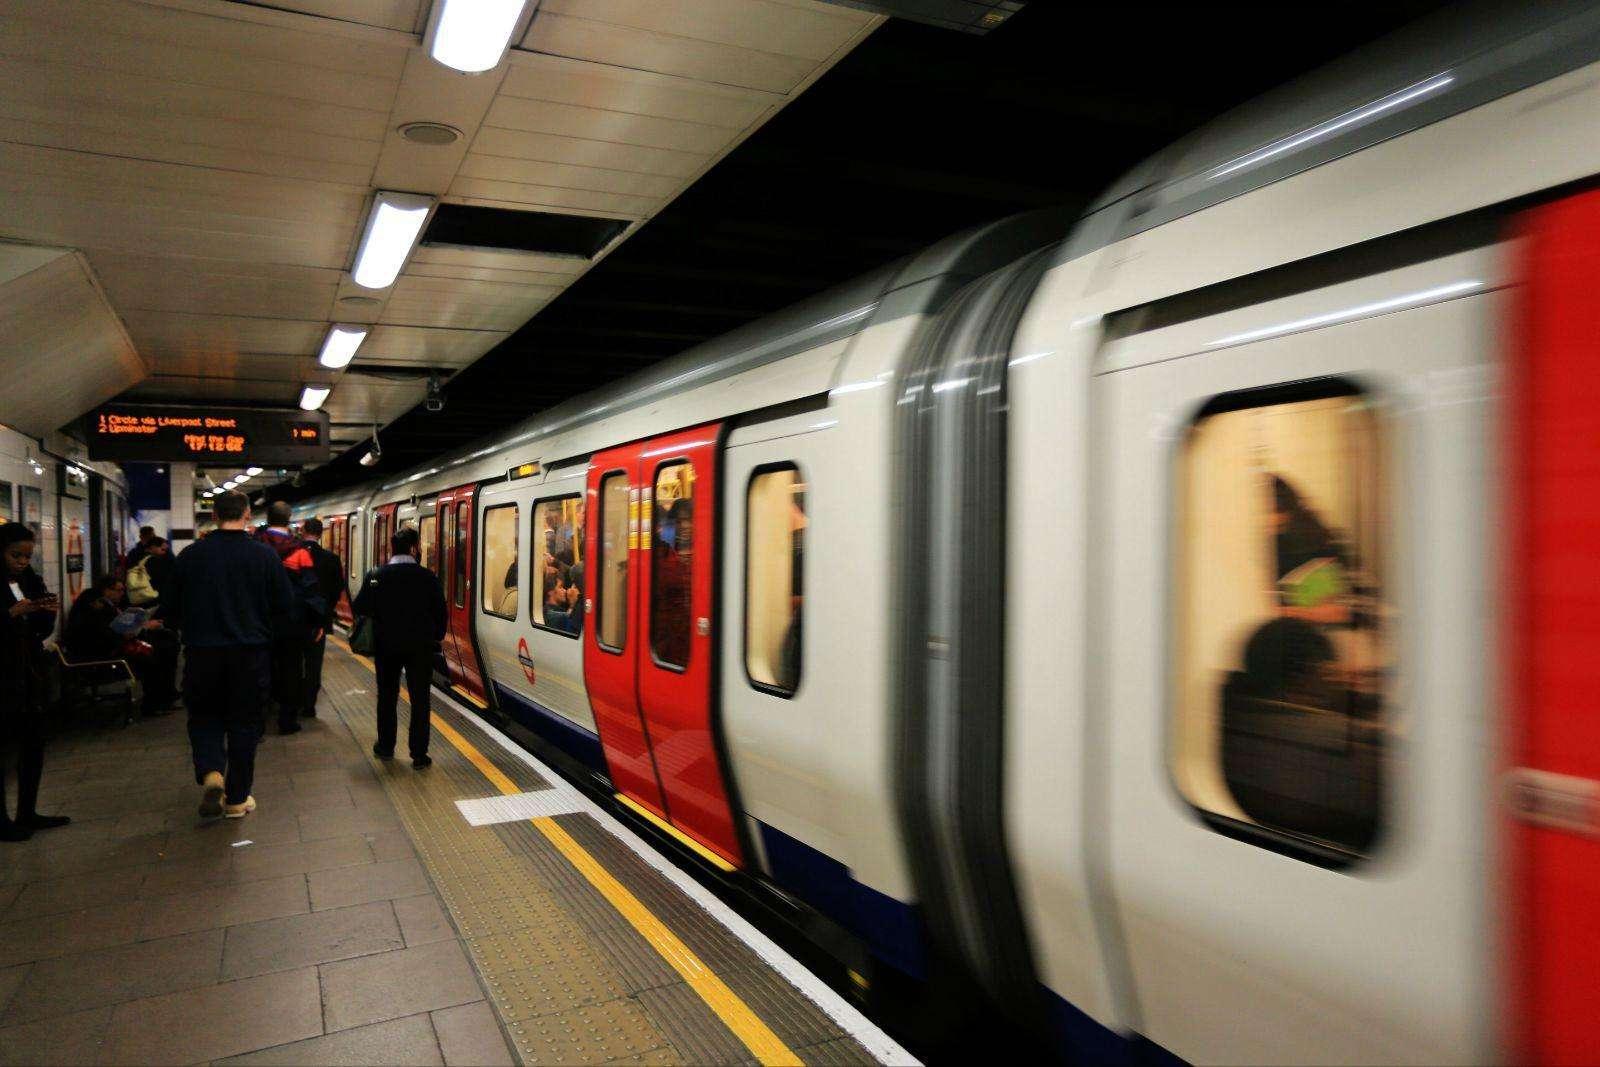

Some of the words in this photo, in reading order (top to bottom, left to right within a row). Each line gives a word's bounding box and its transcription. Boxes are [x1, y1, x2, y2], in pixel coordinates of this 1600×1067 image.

[108, 414, 139, 425] Circle
[141, 416, 157, 425] via
[158, 417, 202, 427] Liverpool
[204, 418, 236, 428] Street
[108, 424, 158, 433] Upminster
